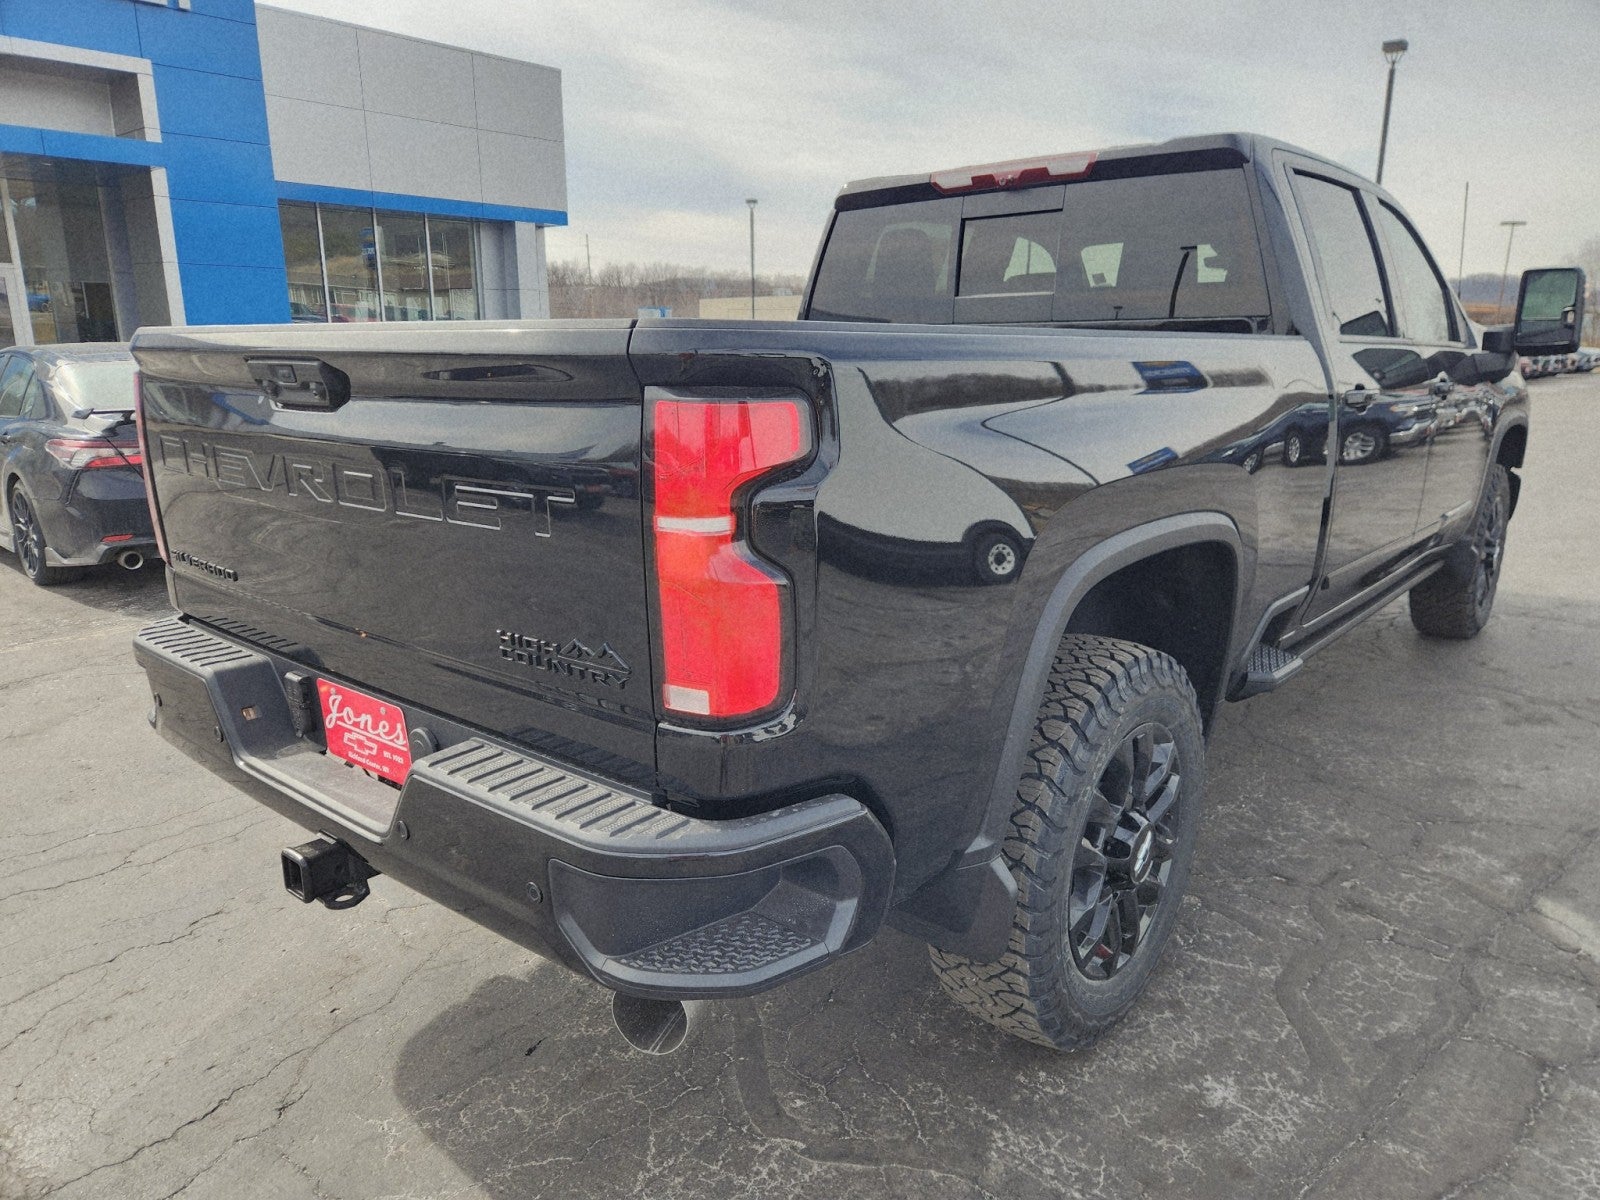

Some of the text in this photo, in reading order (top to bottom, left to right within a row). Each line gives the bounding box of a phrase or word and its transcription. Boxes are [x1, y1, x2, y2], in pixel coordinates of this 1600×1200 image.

[159, 434, 576, 538] CHEVROLET
[171, 549, 239, 582] SILVERADO
[496, 628, 562, 655] HIGH
[499, 645, 632, 690] COUNTRY
[325, 694, 407, 745] Jones
